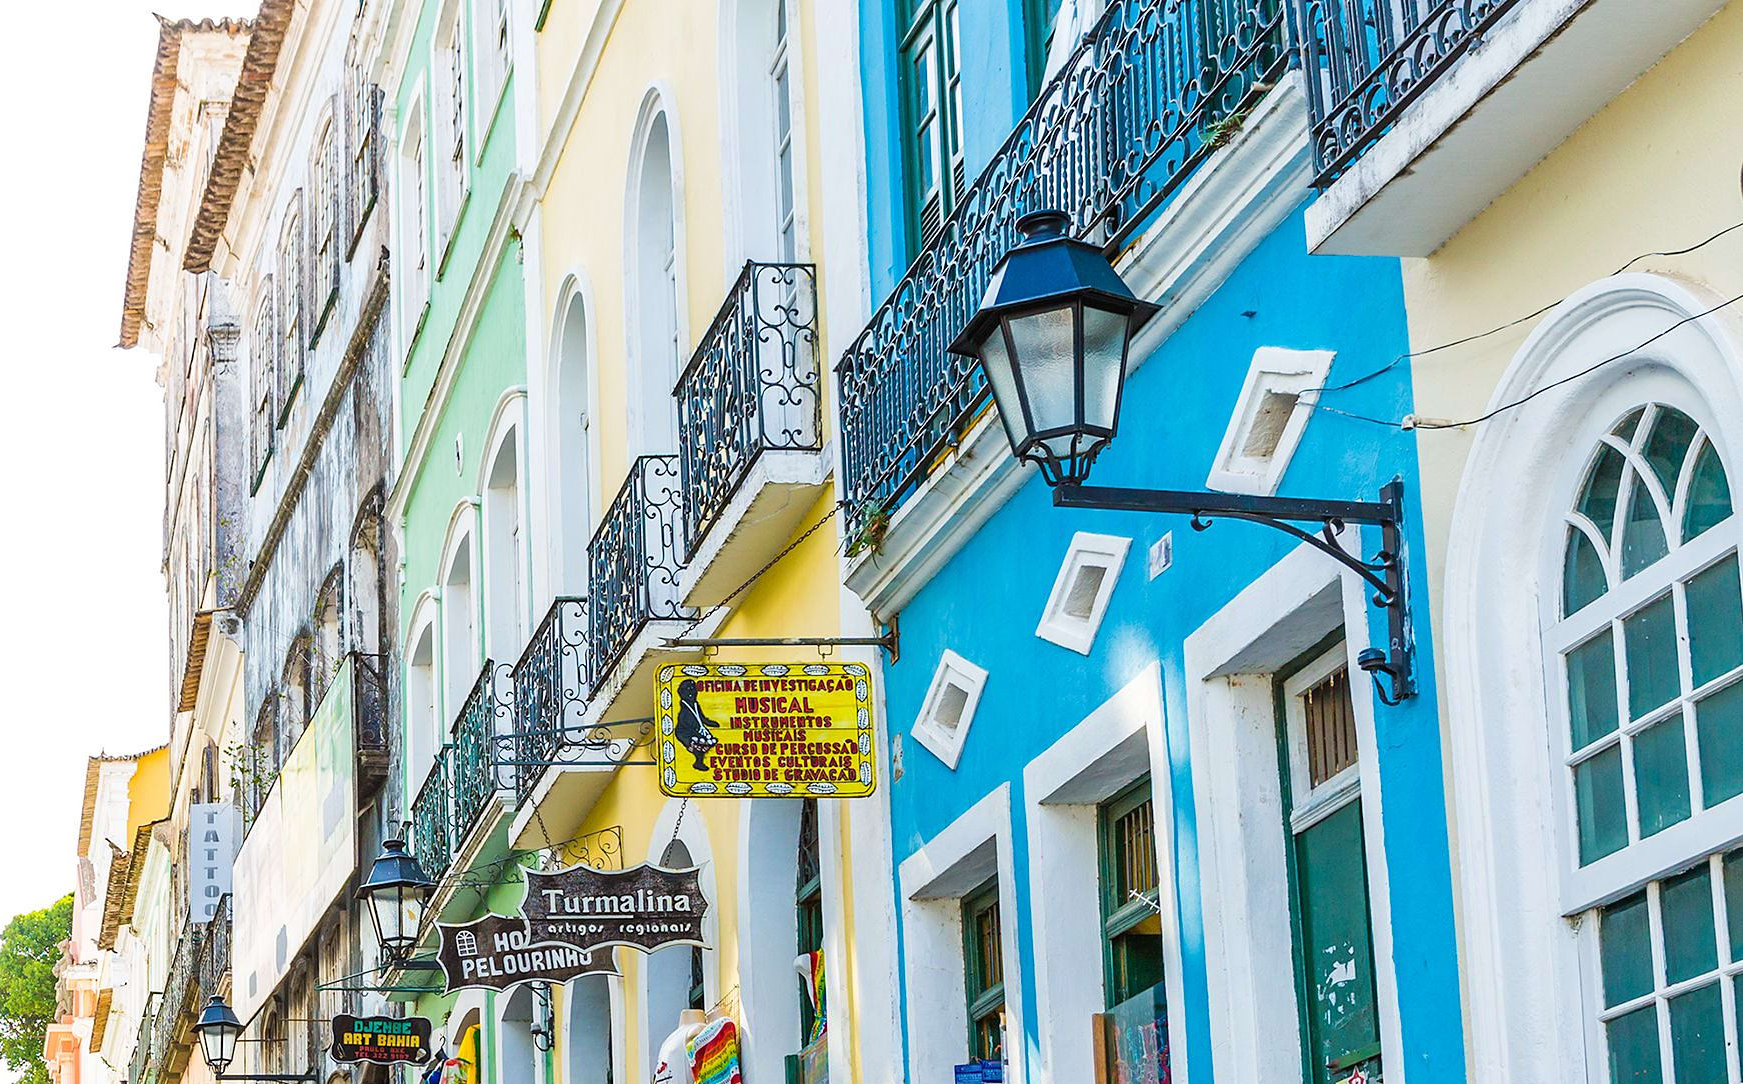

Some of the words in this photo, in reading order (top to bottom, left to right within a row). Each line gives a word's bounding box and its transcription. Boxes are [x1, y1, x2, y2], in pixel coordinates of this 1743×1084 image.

[697, 680, 741, 692] OFICINA
[744, 680, 757, 691] DE
[759, 675, 854, 693] INVESTIGAÇÃO
[735, 697, 814, 713] MUSICAL
[730, 716, 832, 728] INSTRUMENTOS
[743, 729, 806, 742] MUSICAIS
[715, 743, 758, 755] CURSO
[762, 744, 777, 755] DE
[710, 756, 771, 768] EVENTOS
[777, 756, 852, 767] CULTURAIS
[713, 768, 761, 781] STUDIO
[764, 769, 779, 780] DE
[204, 811, 220, 916] TATTOO
[542, 888, 691, 913] Turmalina
[547, 922, 604, 936] artigos
[619, 921, 692, 935] regionais
[462, 948, 593, 979] PELOURINHO
[354, 1020, 411, 1034] DJEMBE
[343, 1033, 372, 1045] ART
[377, 1034, 420, 1047] BAHIA
